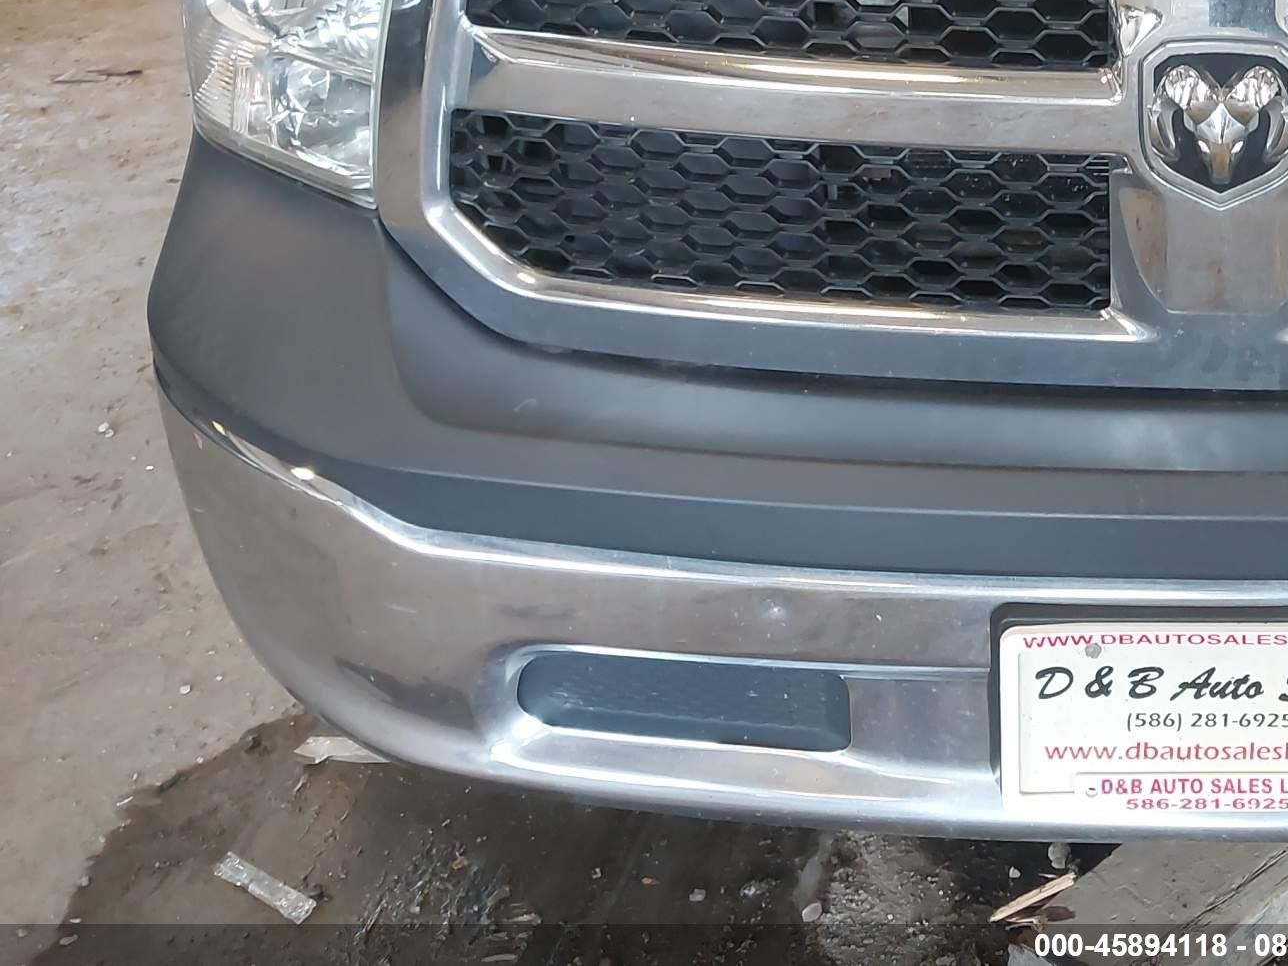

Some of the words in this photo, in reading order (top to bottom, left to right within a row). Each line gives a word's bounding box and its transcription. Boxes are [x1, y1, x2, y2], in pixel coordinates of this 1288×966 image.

[1035, 666, 1074, 700] D
[1085, 665, 1114, 699] &
[1128, 666, 1165, 699] B
[1169, 667, 1265, 702] Auto
[1127, 713, 1183, 732] (586)
[1101, 778, 1143, 795] D&B
[1150, 778, 1204, 795] AUTO
[1210, 778, 1273, 795] SALES
